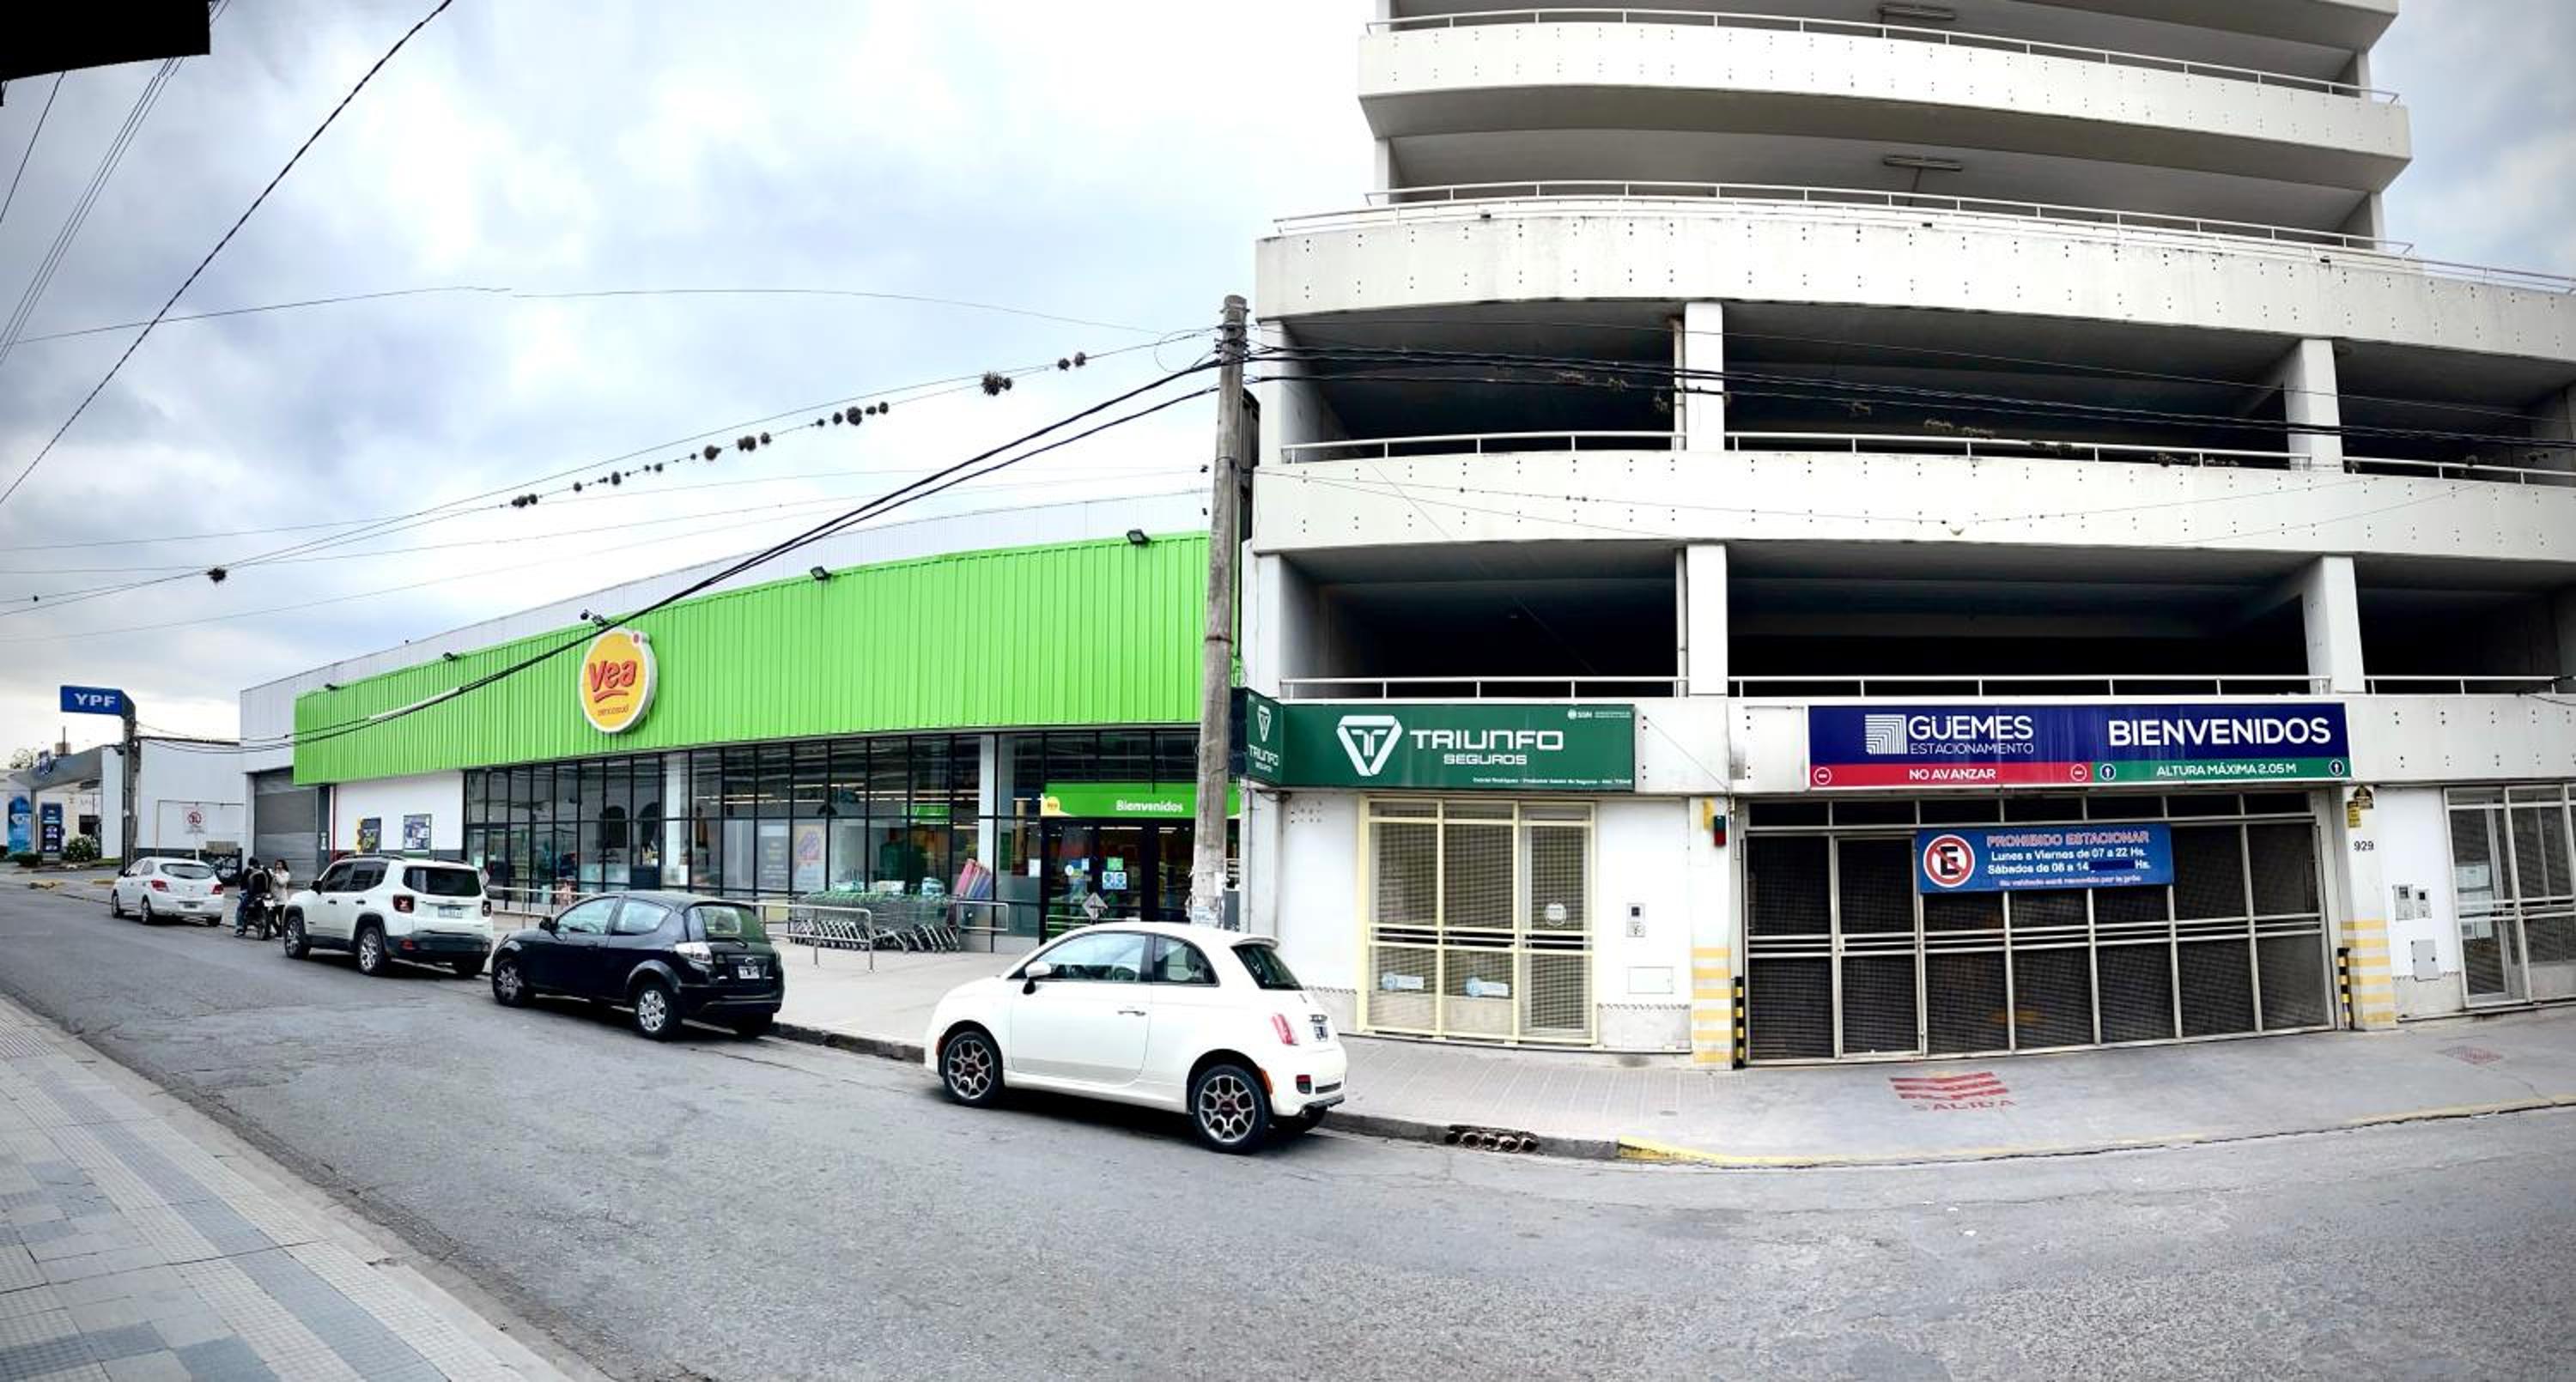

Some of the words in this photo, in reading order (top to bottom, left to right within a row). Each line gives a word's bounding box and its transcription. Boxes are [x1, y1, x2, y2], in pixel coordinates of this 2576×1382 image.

[588, 659, 638, 693] Vea
[74, 693, 116, 707] YPF
[1908, 715, 2033, 740] GÜEMES
[2108, 718, 2331, 747] BIENVENIDOS
[1409, 730, 1564, 750] TRIUNFO
[1910, 743, 2034, 755] ESTACIONAMIENTO
[1443, 754, 1528, 766] SEGUROS
[1909, 769, 1929, 780] NO
[1931, 768, 1996, 780] AVANZAR
[2156, 766, 2204, 777] ALTURA
[2207, 761, 2257, 776] MÁXIMA
[2258, 763, 2284, 774] 2.05
[1115, 800, 1183, 812] Bienvenidos
[1987, 834, 2063, 848] PROHIBIDO
[2065, 830, 2149, 846] ESTACIONAR
[2354, 840, 2374, 852] 929
[1991, 852, 2024, 861] Lunes
[2034, 849, 2075, 860] Viernes
[2076, 849, 2090, 858] de
[2091, 848, 2105, 858] 07
[2106, 849, 2114, 858] a
[2116, 847, 2128, 858] 22
[1987, 863, 2034, 874] Sábados
[2036, 863, 2050, 873] de
[2076, 861, 2089, 871] 14
